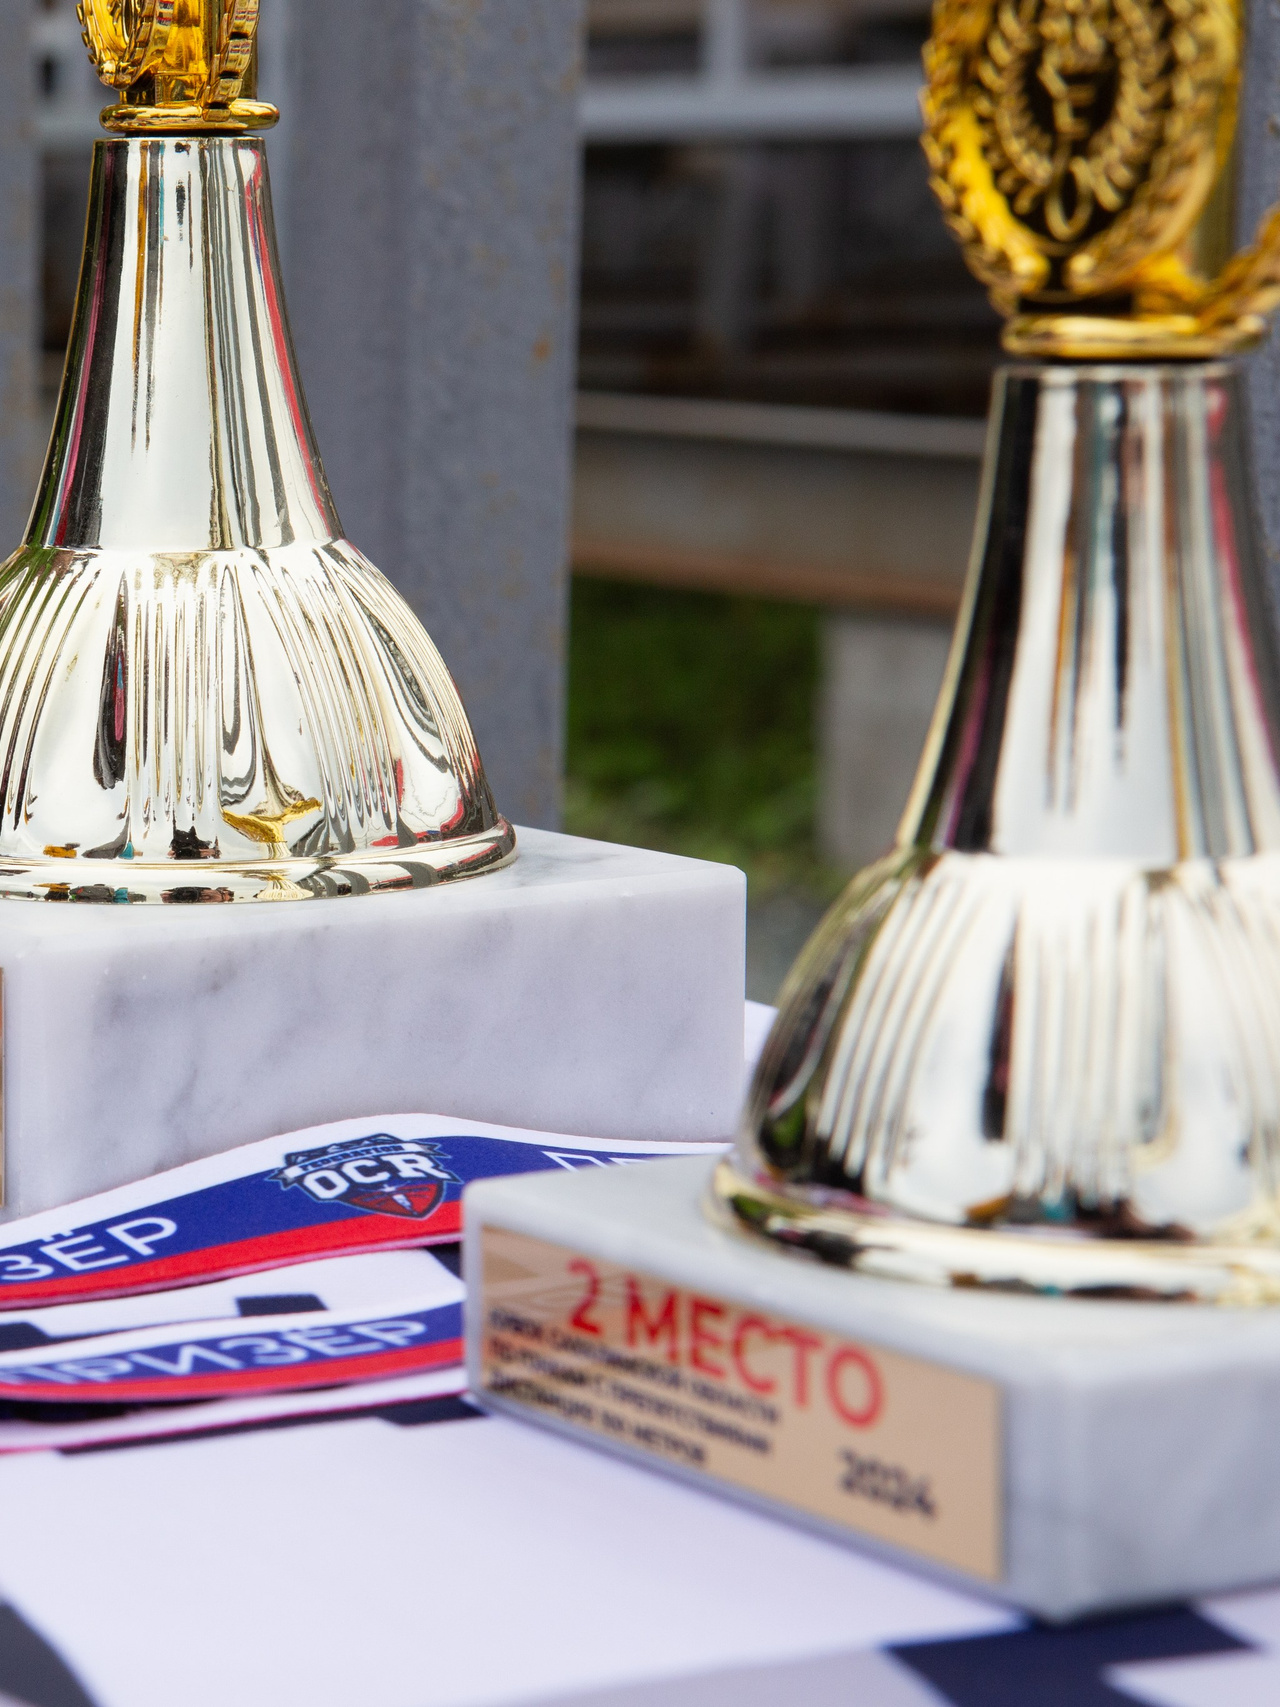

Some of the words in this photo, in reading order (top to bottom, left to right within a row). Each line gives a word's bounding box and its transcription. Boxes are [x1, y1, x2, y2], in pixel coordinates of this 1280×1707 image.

[303, 1153, 452, 1200] OCR
[567, 1259, 604, 1337] 2
[624, 1274, 885, 1430] МЕСТО
